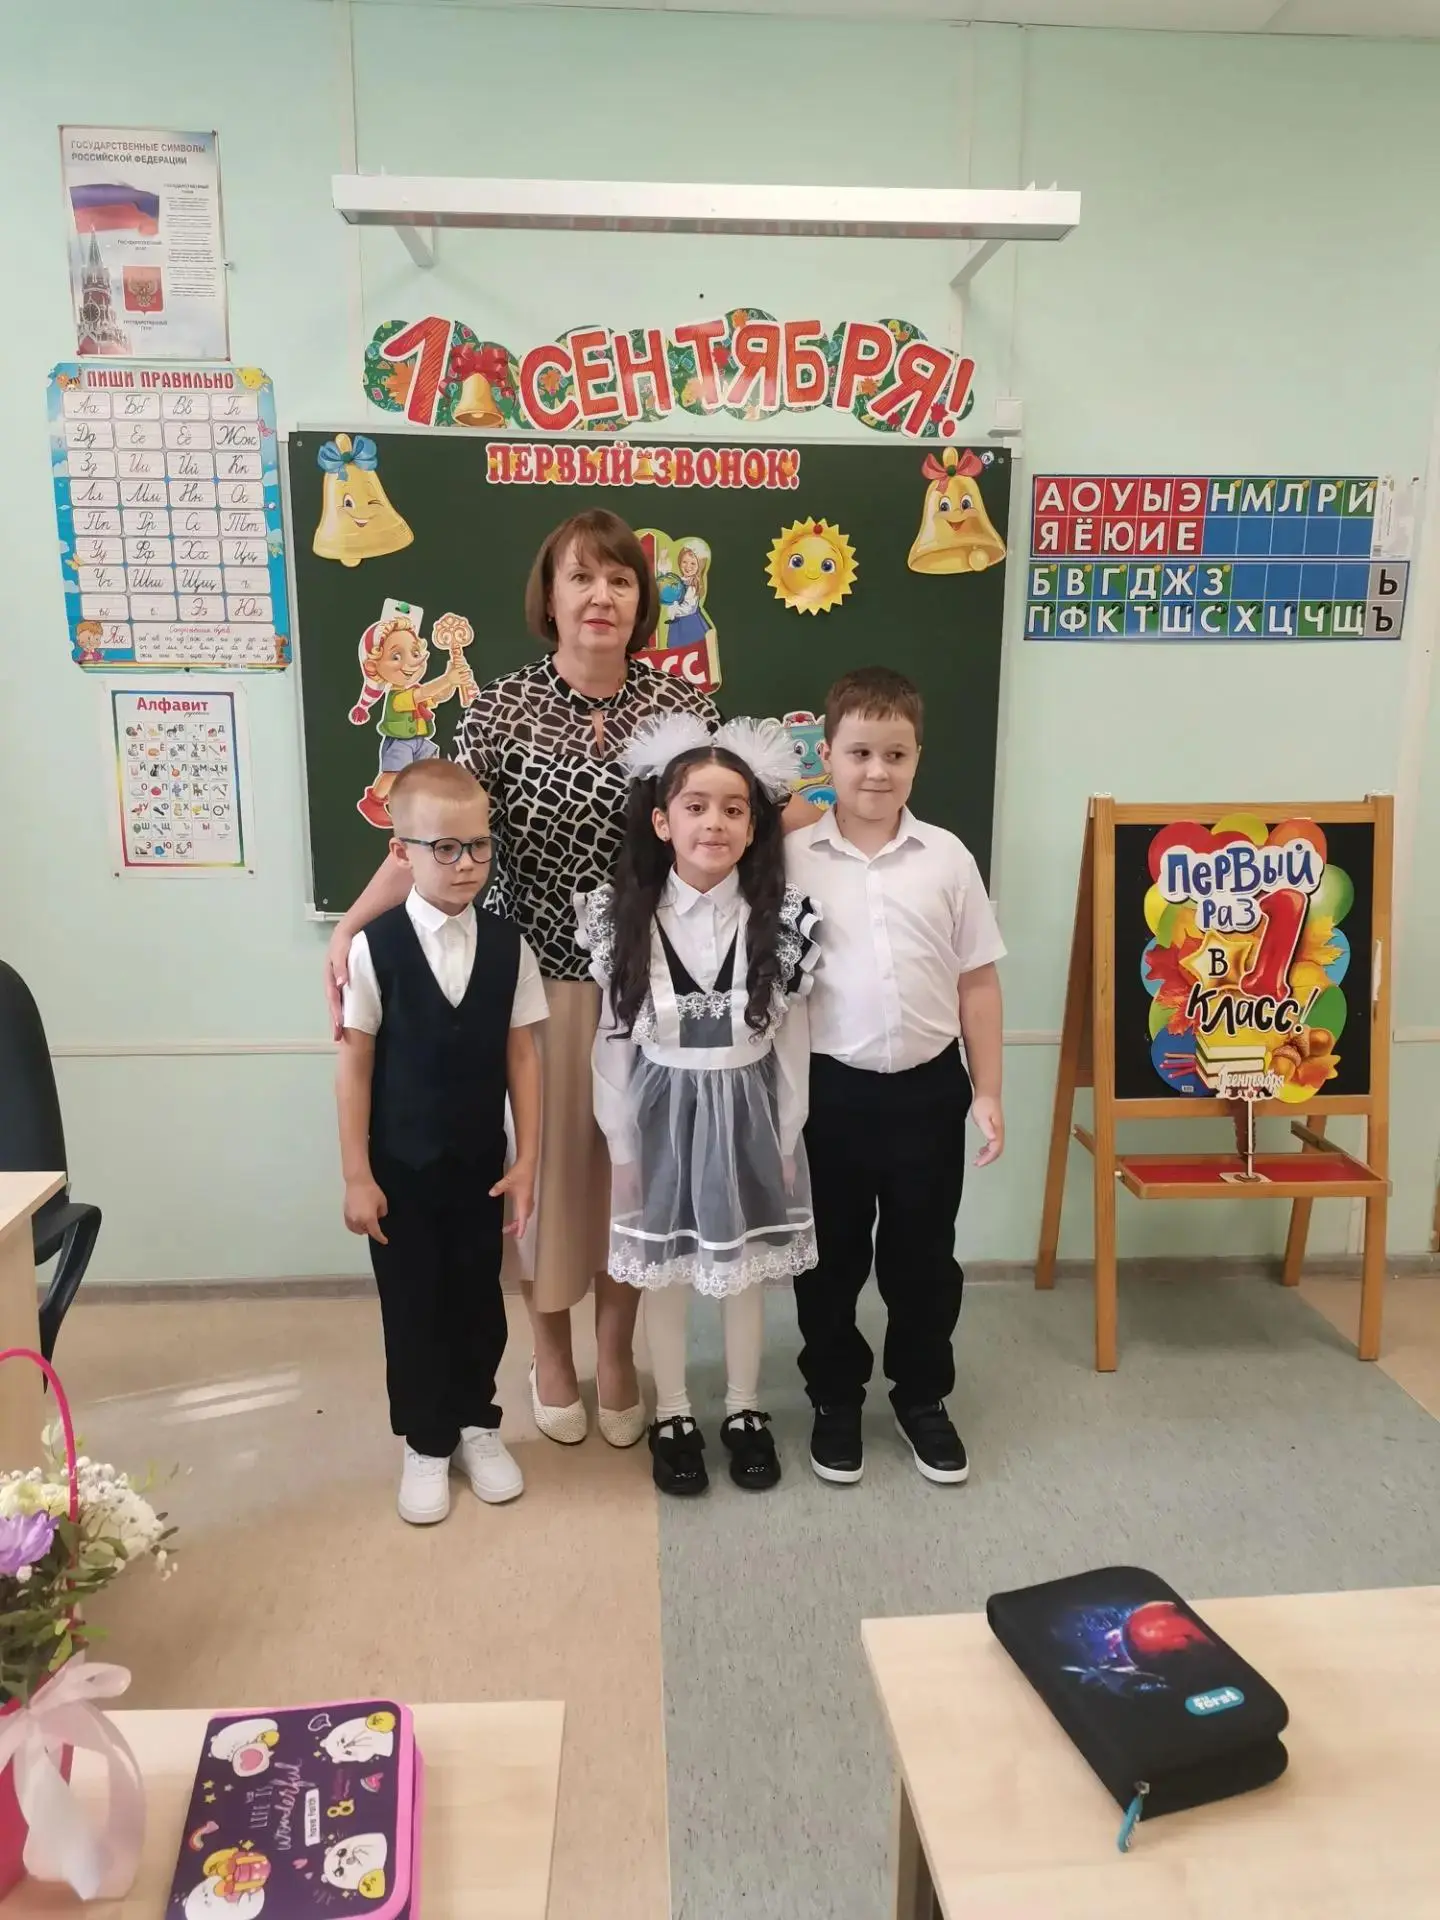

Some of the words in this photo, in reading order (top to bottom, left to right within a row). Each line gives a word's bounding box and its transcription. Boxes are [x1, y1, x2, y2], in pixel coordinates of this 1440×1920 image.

[72, 140, 158, 151] ГОСУДАРСТВЕННЫЕ
[161, 143, 206, 153] СИМВОЛЫ
[72, 152, 132, 162] РОССИЙСКОЙ
[134, 156, 187, 165] ФЕДЕРАЦИИ
[87, 371, 134, 388] ПИШИ
[141, 371, 234, 388] ПРАВИЛЬНО
[519, 318, 975, 437] СЕНТЯБРЯ!
[488, 442, 633, 484] ПЕРВЫЙ
[653, 449, 799, 488] ЗВОНОК!
[1039, 483, 1065, 512] А
[1072, 483, 1101, 512] О
[1110, 482, 1135, 512] У
[1143, 483, 1170, 512] Ы
[1179, 482, 1201, 512] Э
[1211, 483, 1234, 512] Н
[1241, 483, 1272, 512] М
[1278, 483, 1303, 512] Л
[1317, 483, 1336, 513] Р
[1348, 481, 1374, 513] Й
[1039, 521, 1060, 551] Я
[1074, 518, 1092, 551] Ё
[1104, 522, 1135, 552] Ю
[1140, 522, 1165, 552] И
[1177, 522, 1196, 551] Е
[1032, 569, 1051, 596] Б
[1067, 568, 1085, 596] В
[1102, 569, 1121, 596] Г
[1129, 568, 1157, 600] Д
[1163, 568, 1193, 596] Ж
[1203, 568, 1223, 596] З
[1379, 569, 1398, 596] Ь
[1028, 606, 1049, 633] П
[1059, 606, 1088, 633] Ф
[1098, 606, 1119, 633] К
[1134, 606, 1155, 633] Т
[1162, 606, 1192, 633] Ш
[1200, 606, 1221, 634] С
[1234, 606, 1256, 633] Х
[1269, 606, 1293, 635] Ц
[1304, 606, 1324, 633] Ч
[1333, 606, 1364, 636] Щ
[1372, 607, 1394, 632] Ъ
[137, 697, 208, 714] Алфавит
[1240, 888, 1308, 1000] 1
[1187, 984, 1319, 1035] Класс!
[270, 1758, 316, 1850] wonderful
[308, 1819, 317, 1837] have
